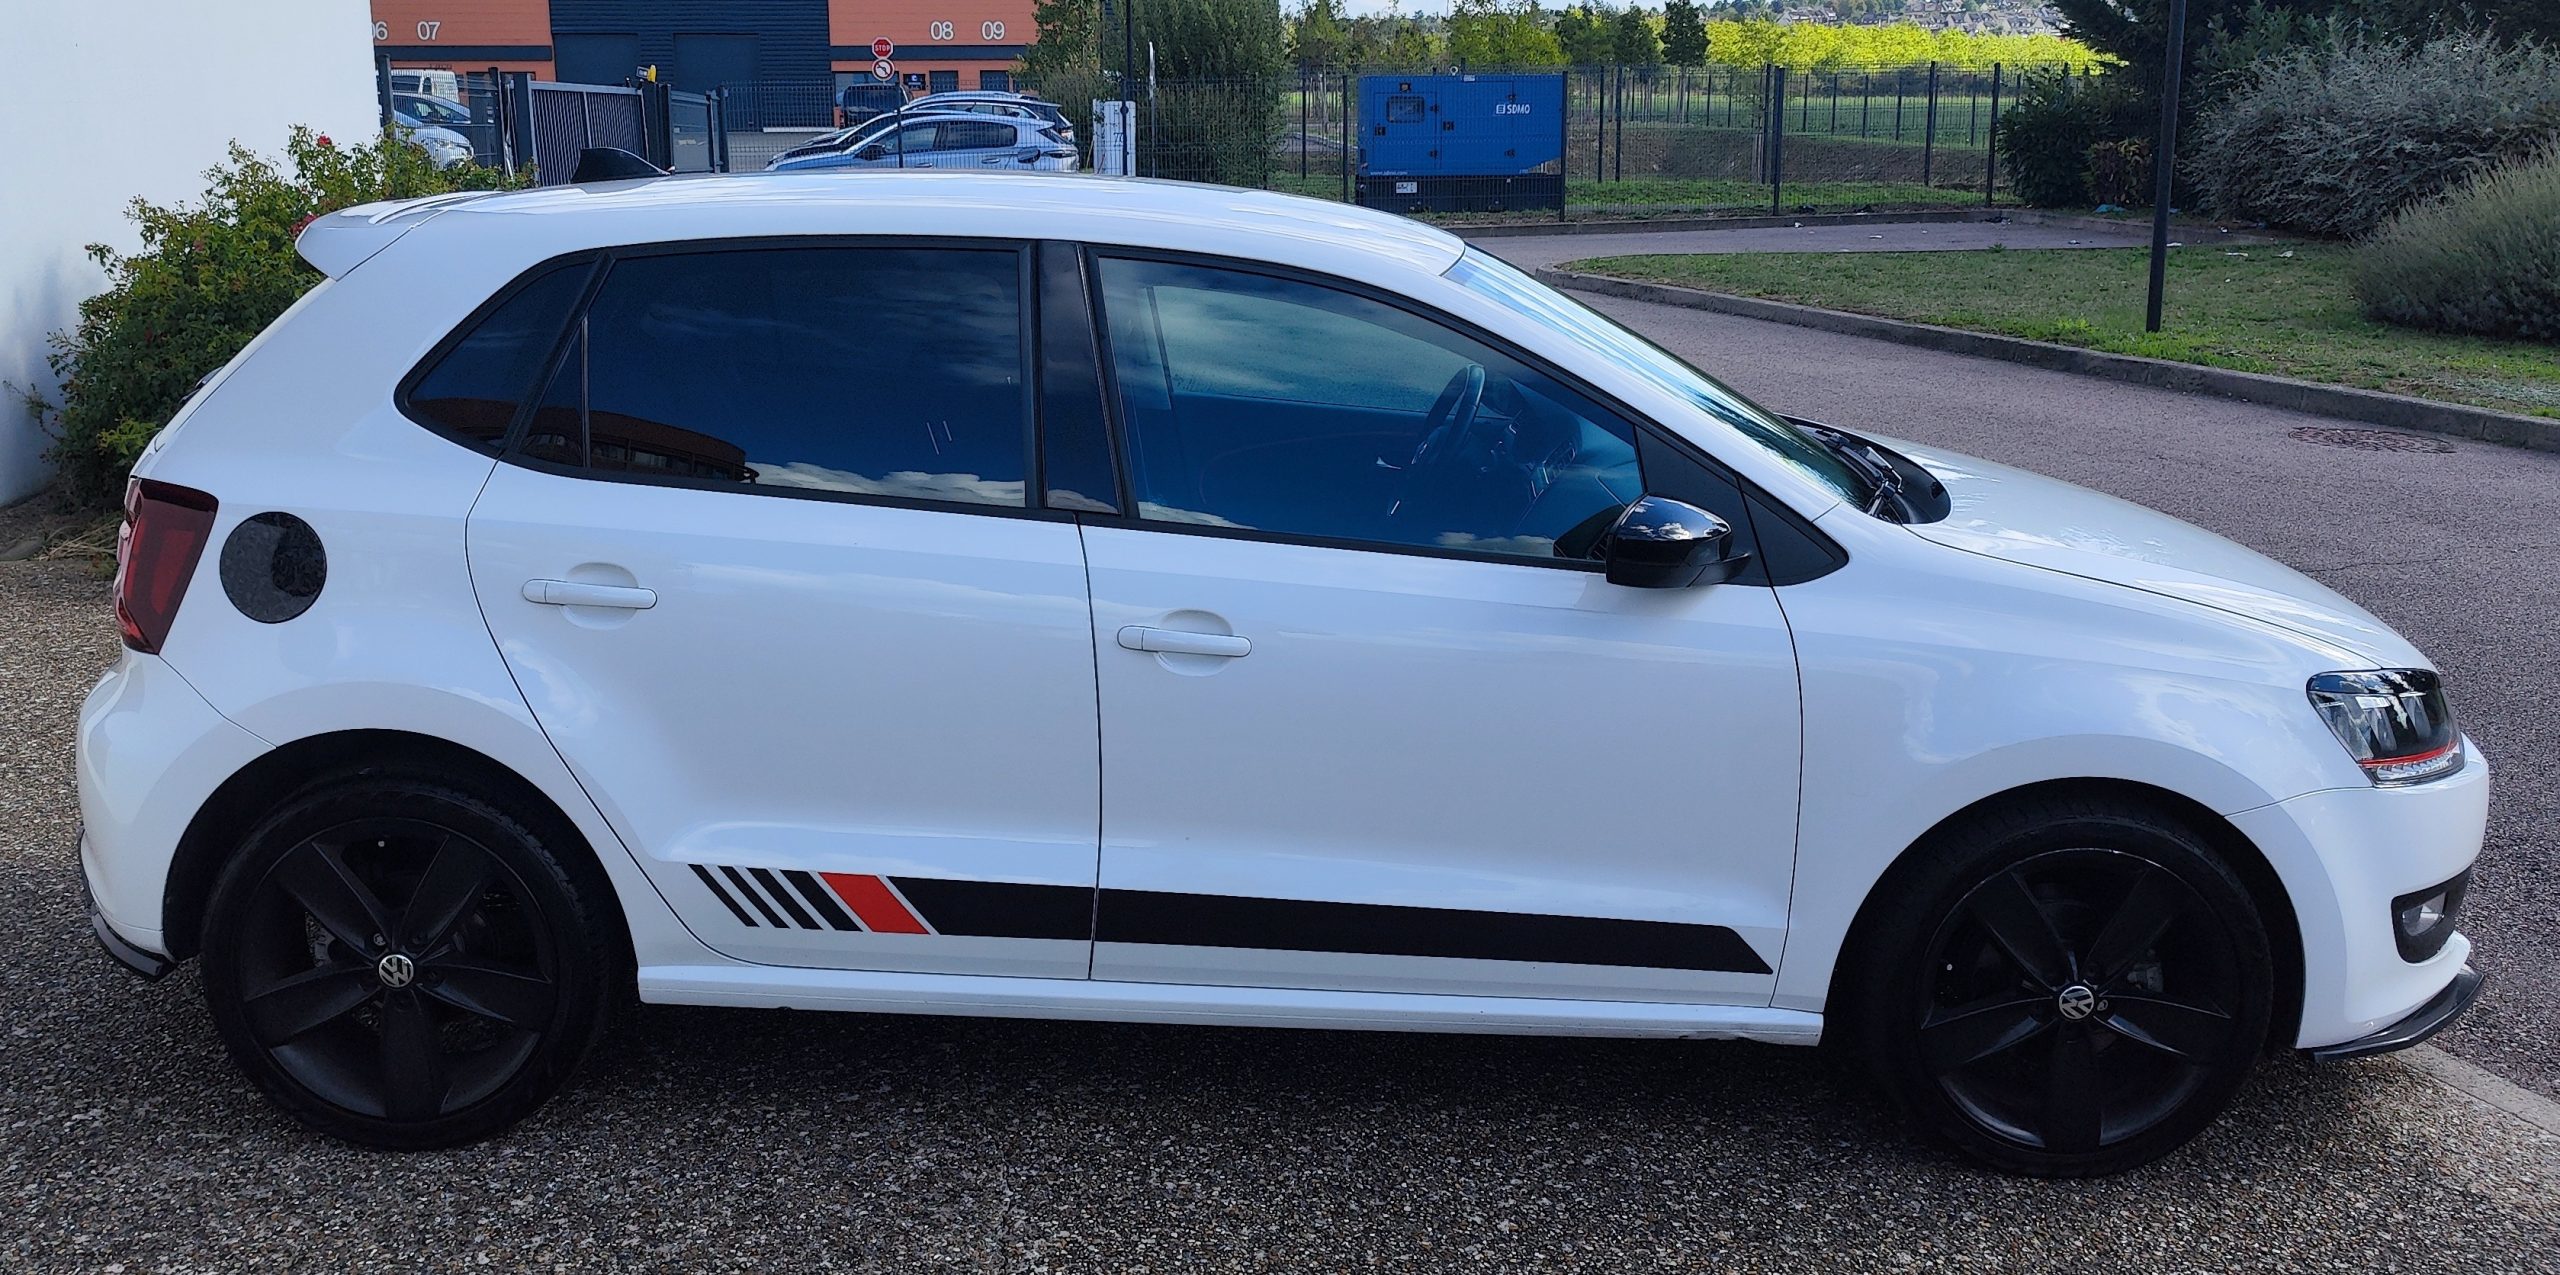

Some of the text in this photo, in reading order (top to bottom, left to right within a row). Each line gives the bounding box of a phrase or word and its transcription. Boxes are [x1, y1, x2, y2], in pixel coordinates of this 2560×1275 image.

[417, 21, 440, 40] 07
[930, 21, 954, 40] 08
[982, 21, 1005, 40] 09
[874, 44, 890, 52] STOP
[1507, 104, 1530, 115] SDMO
